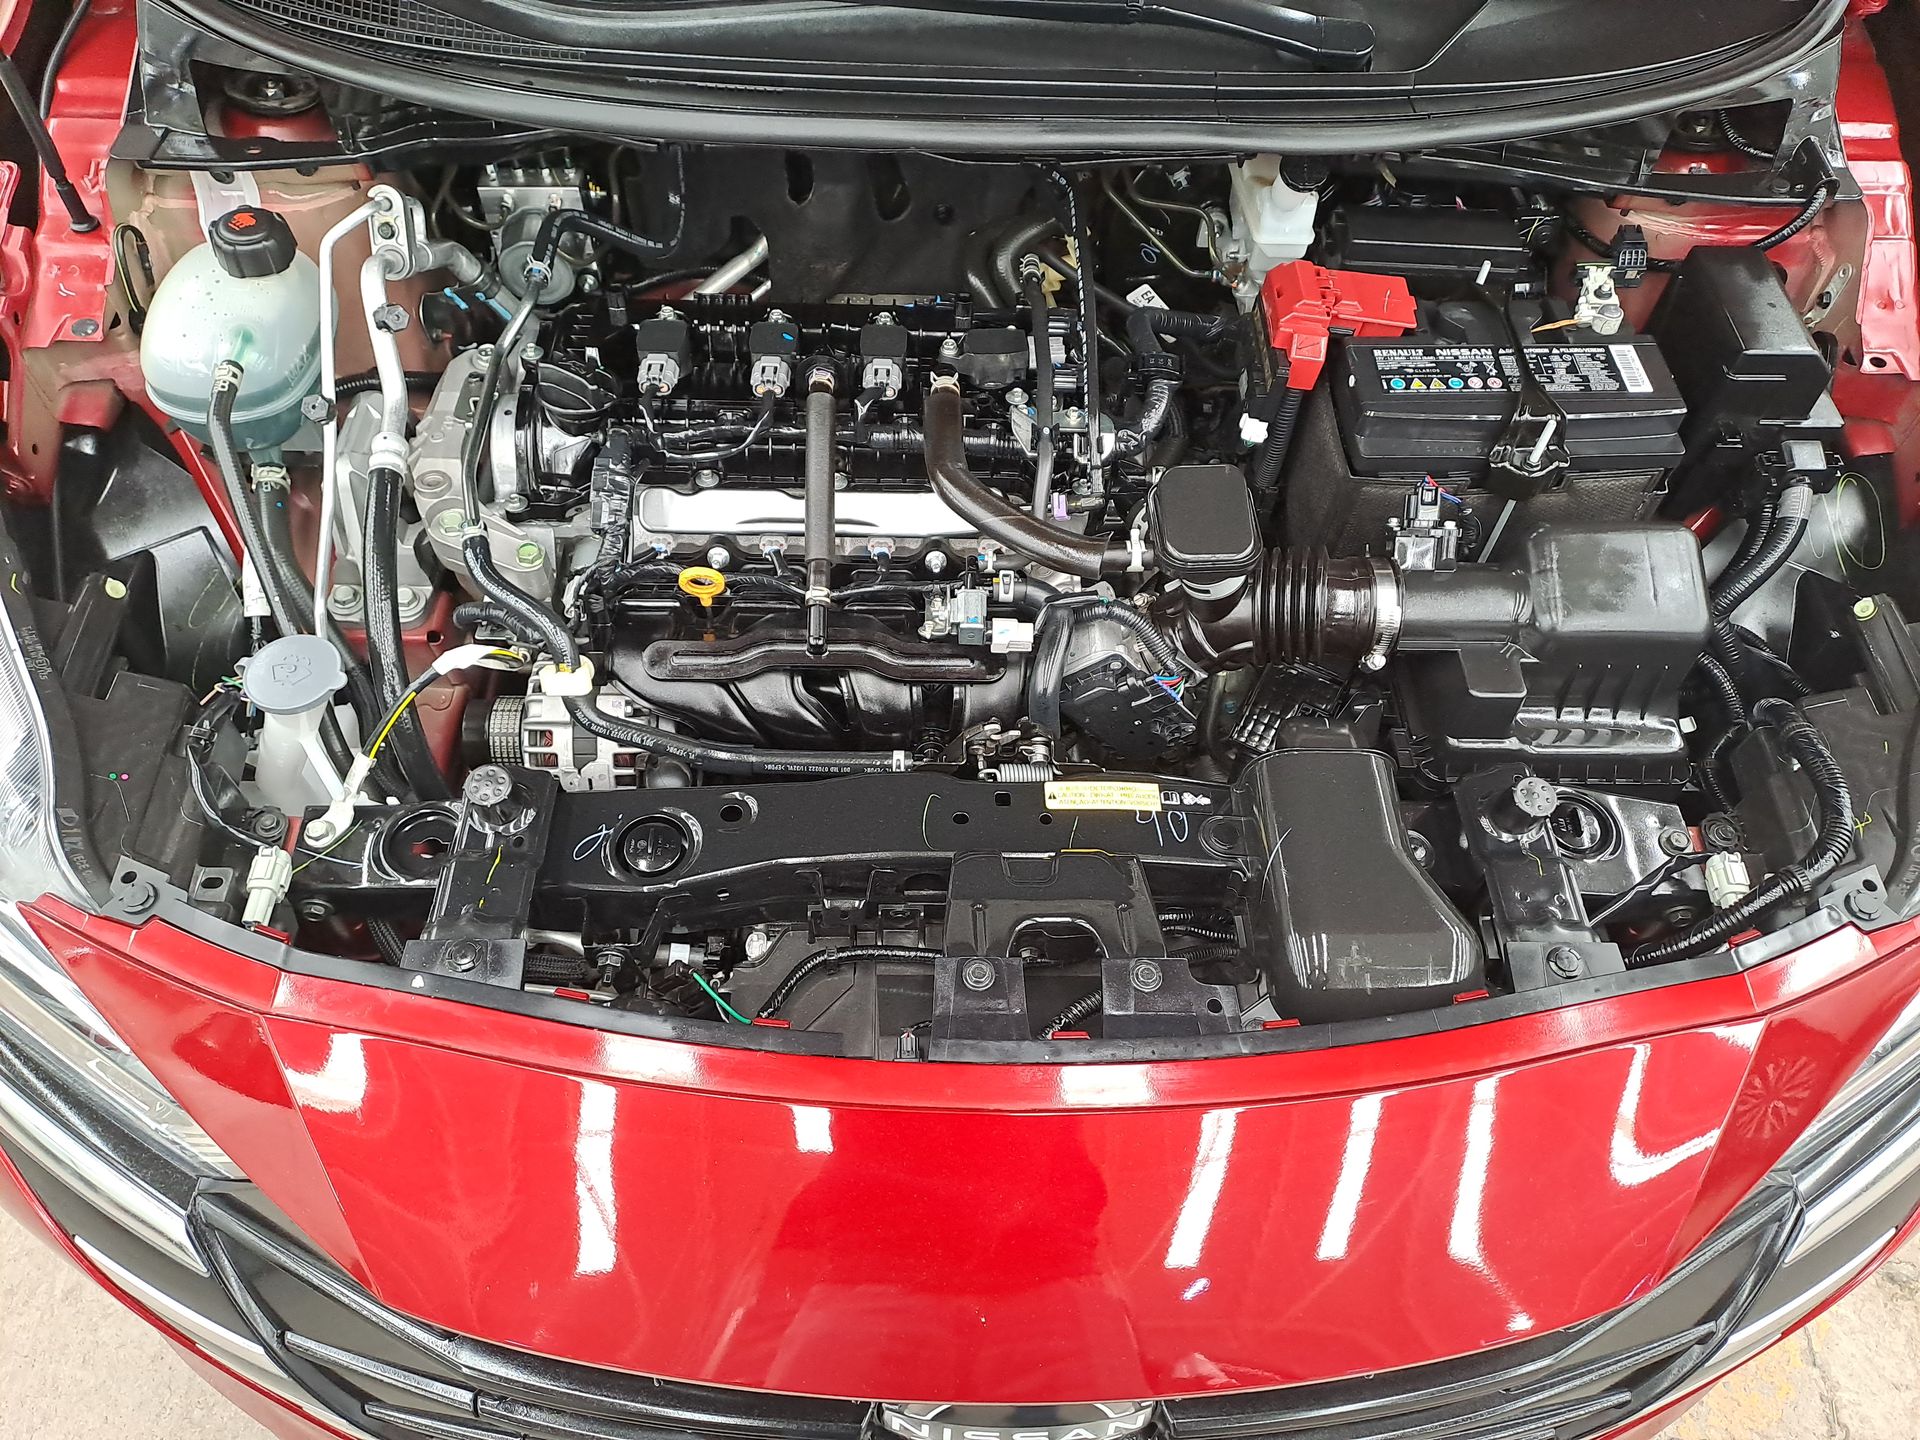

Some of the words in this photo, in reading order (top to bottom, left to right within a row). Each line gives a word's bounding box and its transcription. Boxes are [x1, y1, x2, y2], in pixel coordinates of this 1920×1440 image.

[1373, 349, 1424, 357] RENAULT
[1435, 348, 1493, 356] NISSAN
[891, 1413, 1146, 1440] NISSAN
